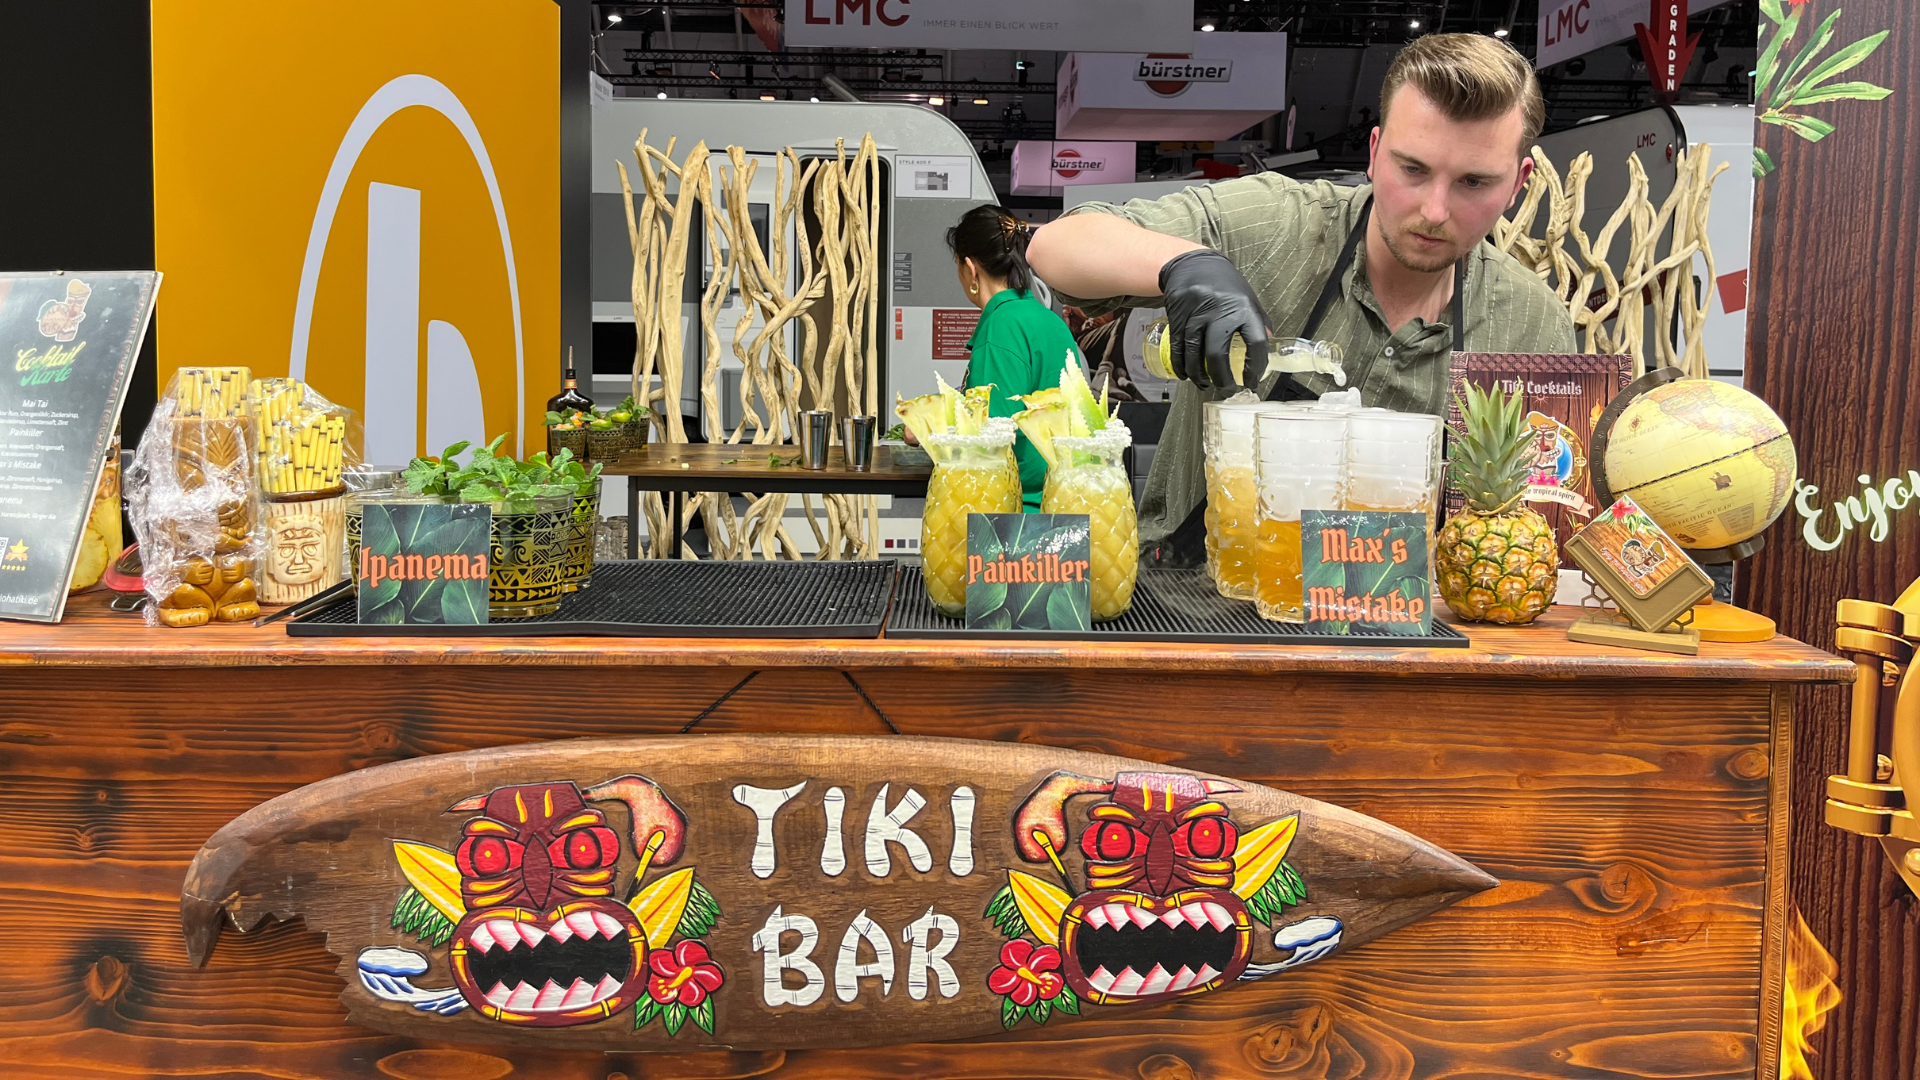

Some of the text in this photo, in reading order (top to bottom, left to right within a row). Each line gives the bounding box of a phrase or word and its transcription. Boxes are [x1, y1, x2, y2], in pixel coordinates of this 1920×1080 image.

[805, 0, 910, 27] LMC
[1544, 0, 1590, 48] LMC
[923, 19, 957, 28] IMMER
[960, 20, 992, 29] EINEN
[995, 20, 1026, 30] BLICK
[1666, 0, 1679, 91] GRADEN
[1138, 61, 1227, 80] bürstner
[1636, 132, 1657, 149] LMC
[1051, 158, 1103, 170] bürstner
[15, 341, 87, 372] Cocktail
[20, 363, 73, 387] Karte
[1527, 380, 1583, 395] Cocktails
[22, 399, 49, 408] Mai Tai
[9, 427, 44, 437] Painkiller
[13, 460, 42, 469] Mistake
[1532, 487, 1558, 497] tropical
[1558, 491, 1576, 501] spirit
[1706, 503, 1732, 515] OCEAN
[1319, 527, 1409, 565] Max's
[360, 546, 488, 589] Ipanema
[967, 553, 1089, 585] Painkiller
[0, 593, 39, 605] lohatiki.de
[1308, 585, 1425, 624] Mistake
[731, 780, 976, 879] TIKI
[752, 904, 961, 1007] BAR
